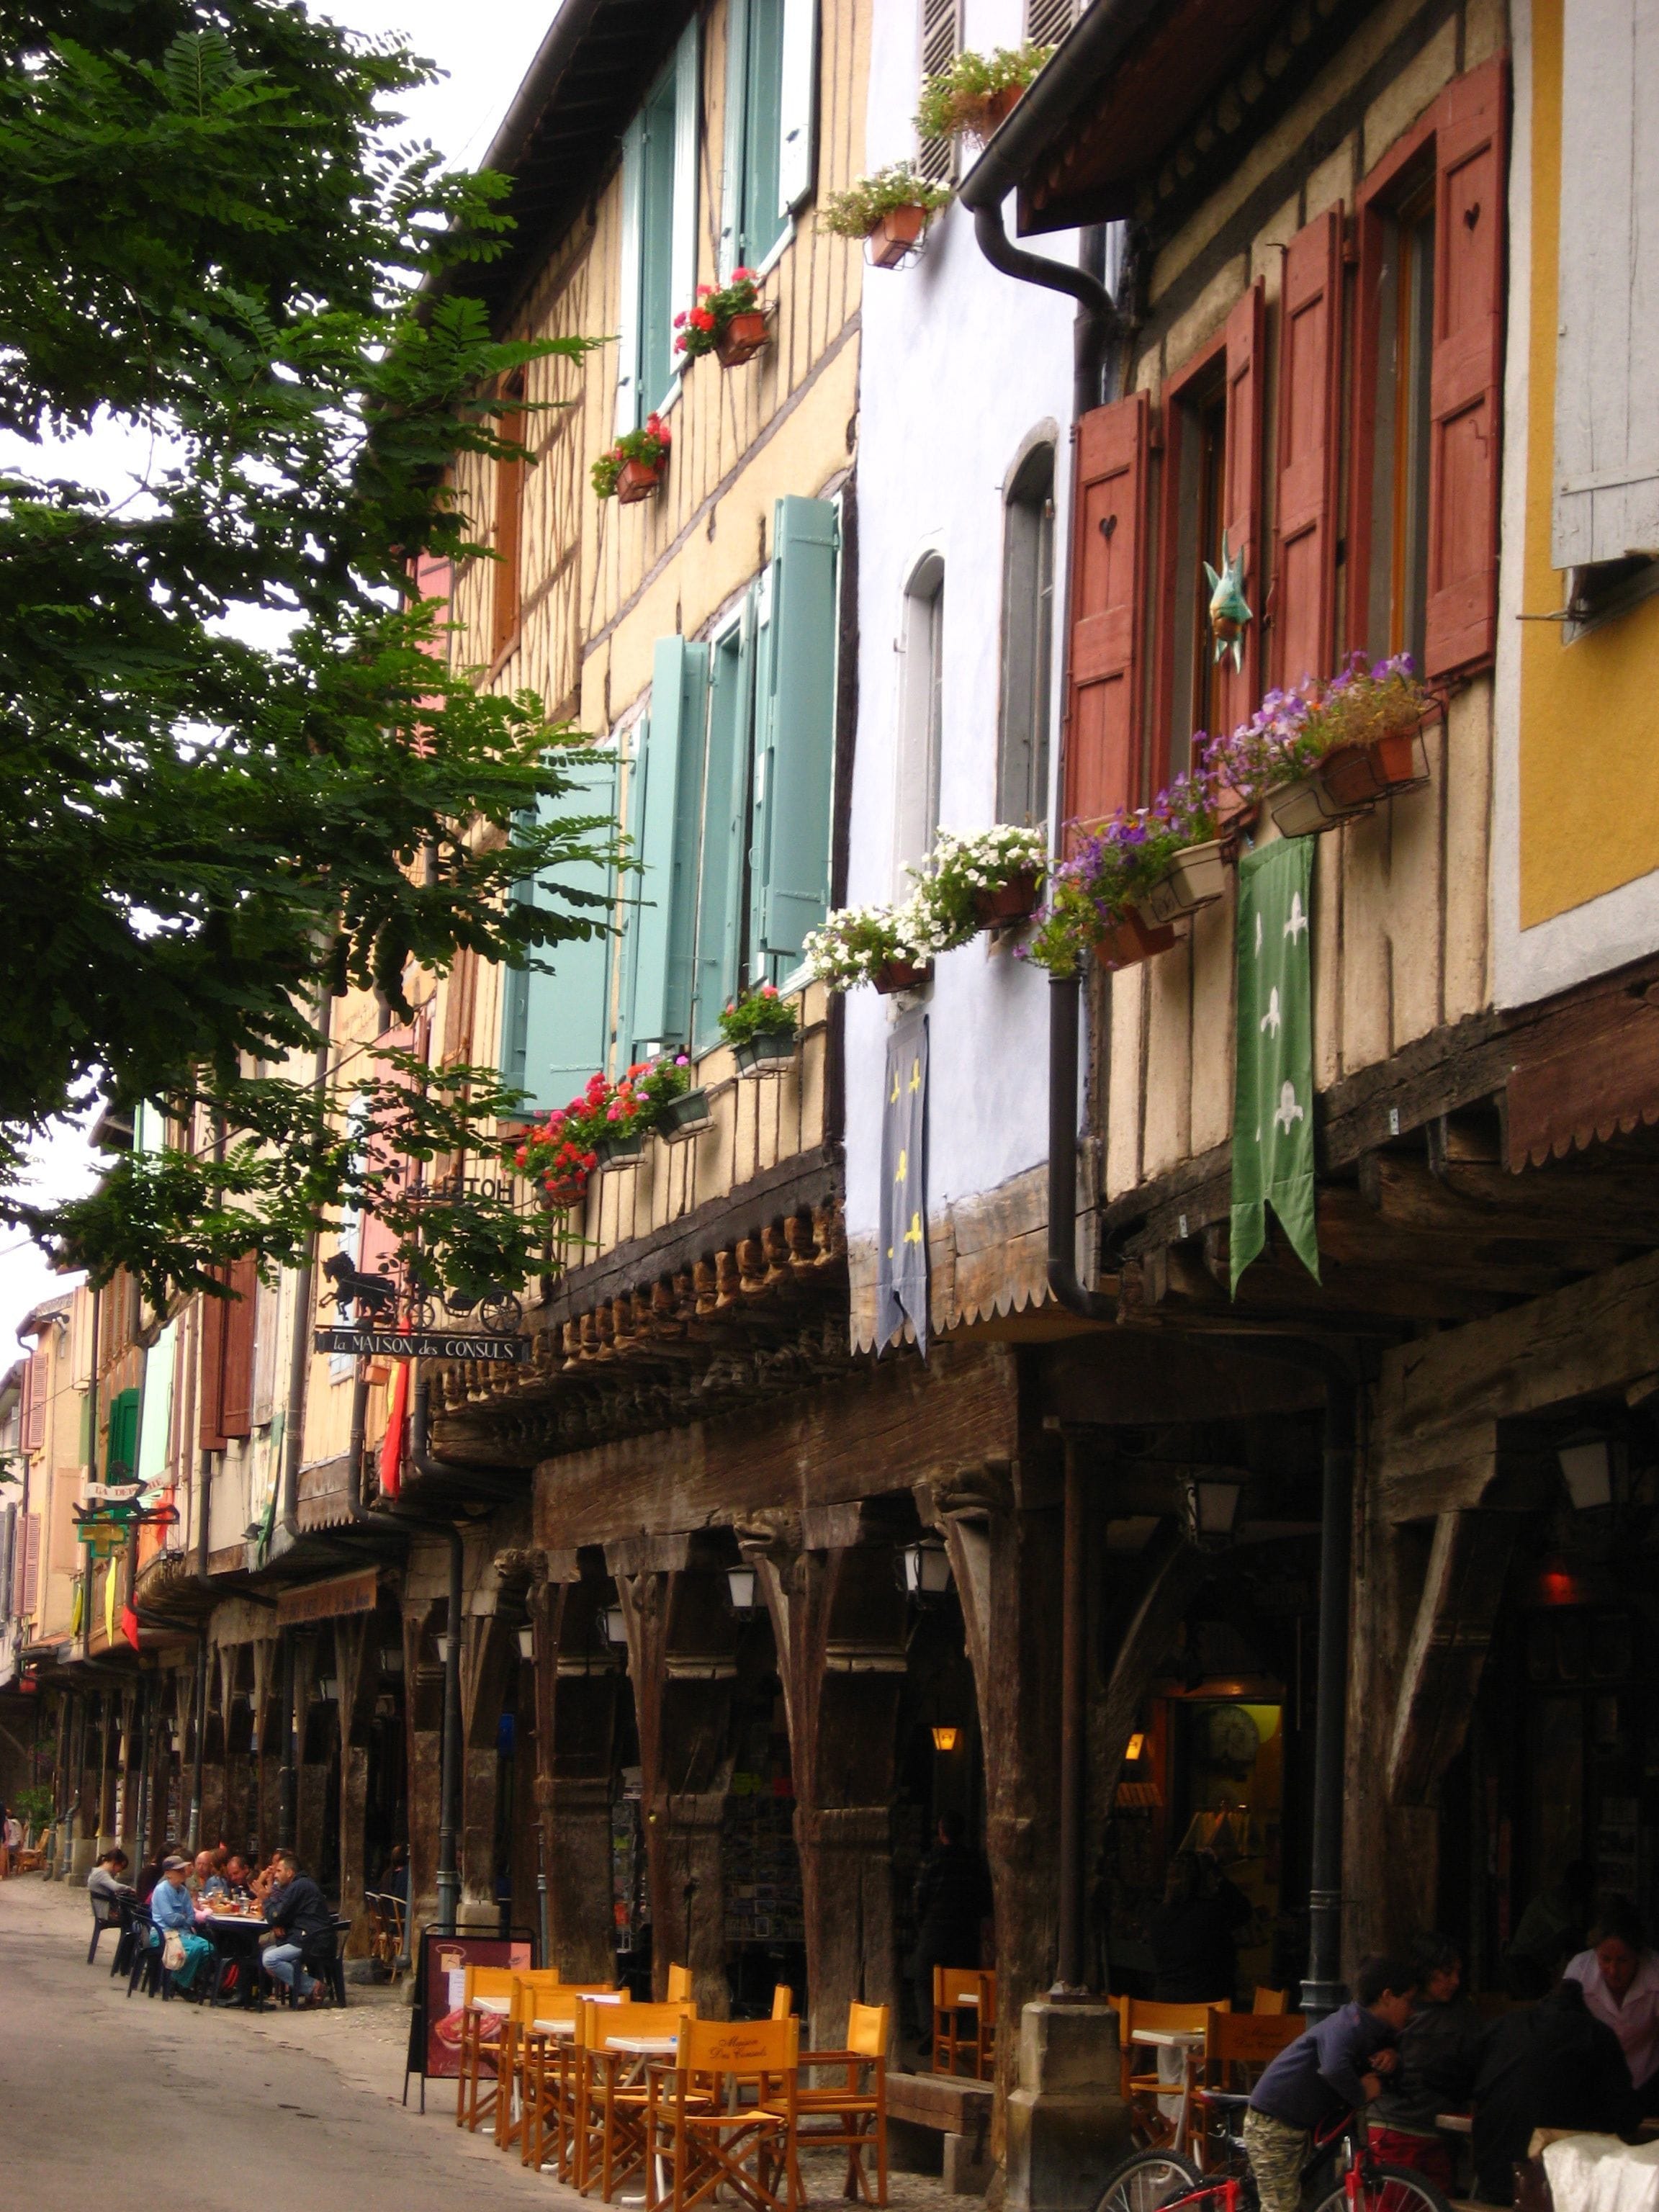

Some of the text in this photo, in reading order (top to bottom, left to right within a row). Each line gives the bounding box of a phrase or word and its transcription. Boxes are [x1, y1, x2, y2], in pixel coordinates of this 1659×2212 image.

[333, 1335, 513, 1358] la MAISON des CONSULS
